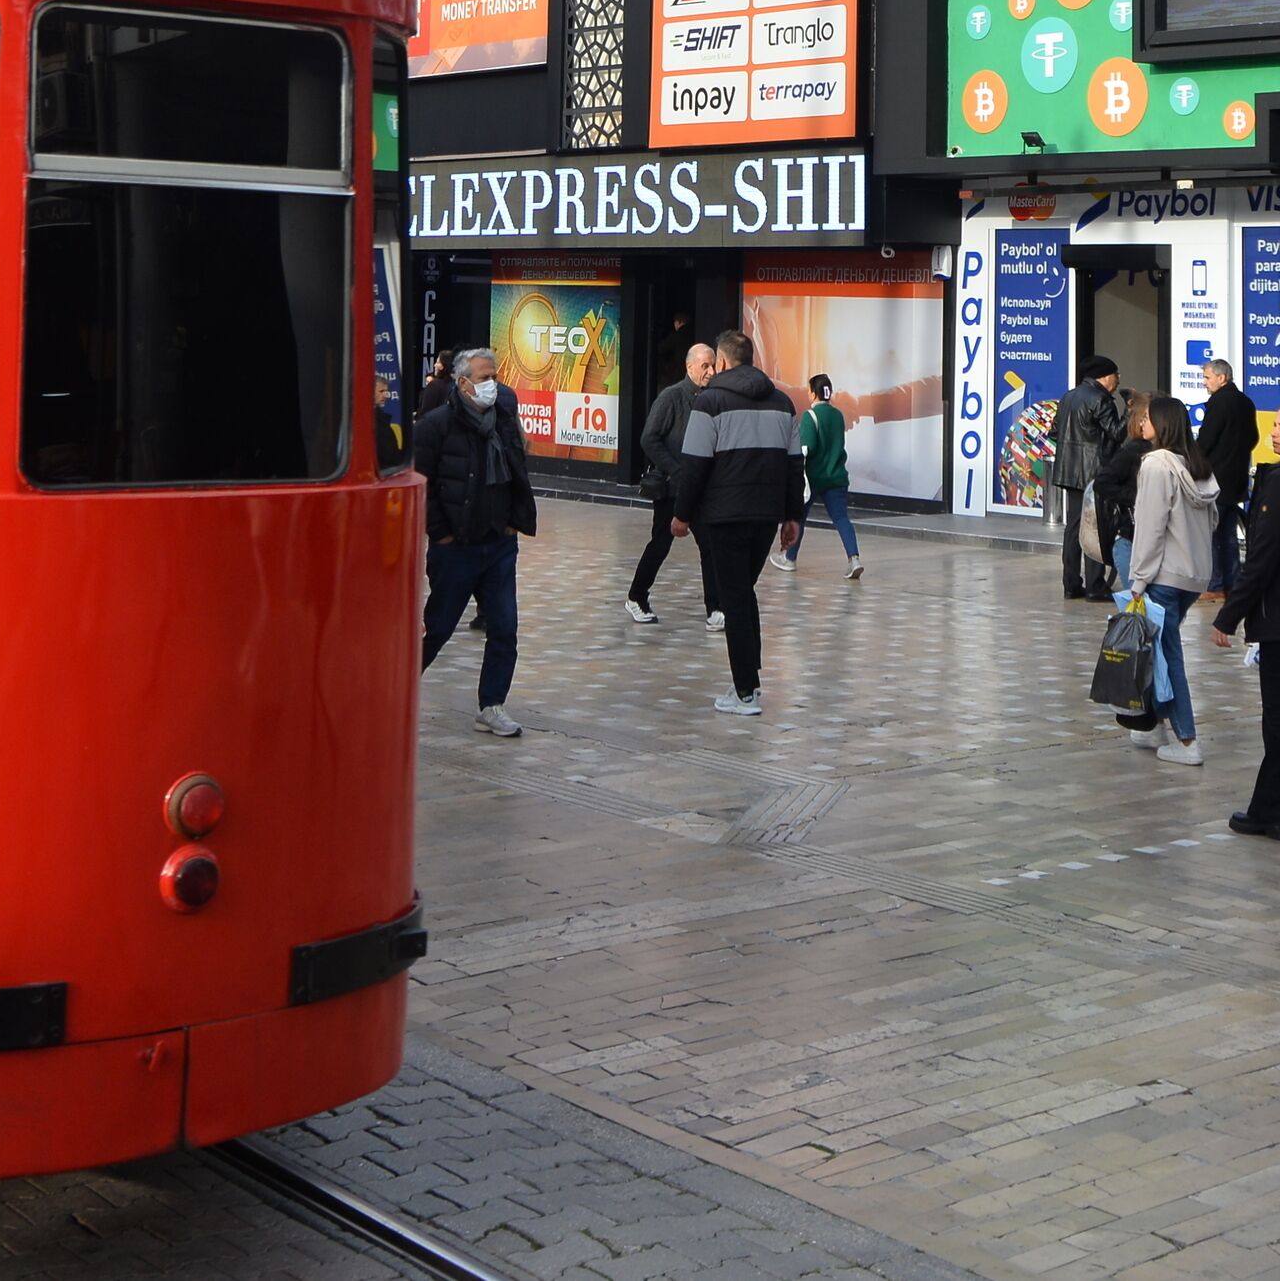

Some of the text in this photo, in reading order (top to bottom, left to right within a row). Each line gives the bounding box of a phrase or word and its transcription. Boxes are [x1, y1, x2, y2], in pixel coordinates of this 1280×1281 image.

[442, 0, 479, 22] MONEY
[684, 24, 741, 52] SHIFT
[764, 18, 834, 48] Tranglo
[673, 82, 735, 116] inpay
[759, 81, 837, 102] terrapay
[1009, 195, 1055, 208] MasterCard
[1118, 187, 1216, 225] Paybol
[1046, 243, 1057, 256] ol
[1001, 261, 1047, 274] mutlu ol
[757, 266, 833, 283] ОТПРАВЛЯЙТЕ
[835, 268, 879, 285] ДЕНЬГИ
[1001, 296, 1051, 310] Используя
[1001, 314, 1048, 328] Paybol вы
[1000, 331, 1032, 344] будете
[1249, 336, 1267, 345] это
[1000, 350, 1052, 362] счастливы
[572, 395, 607, 431] ria
[561, 430, 616, 445] Money Transfer
